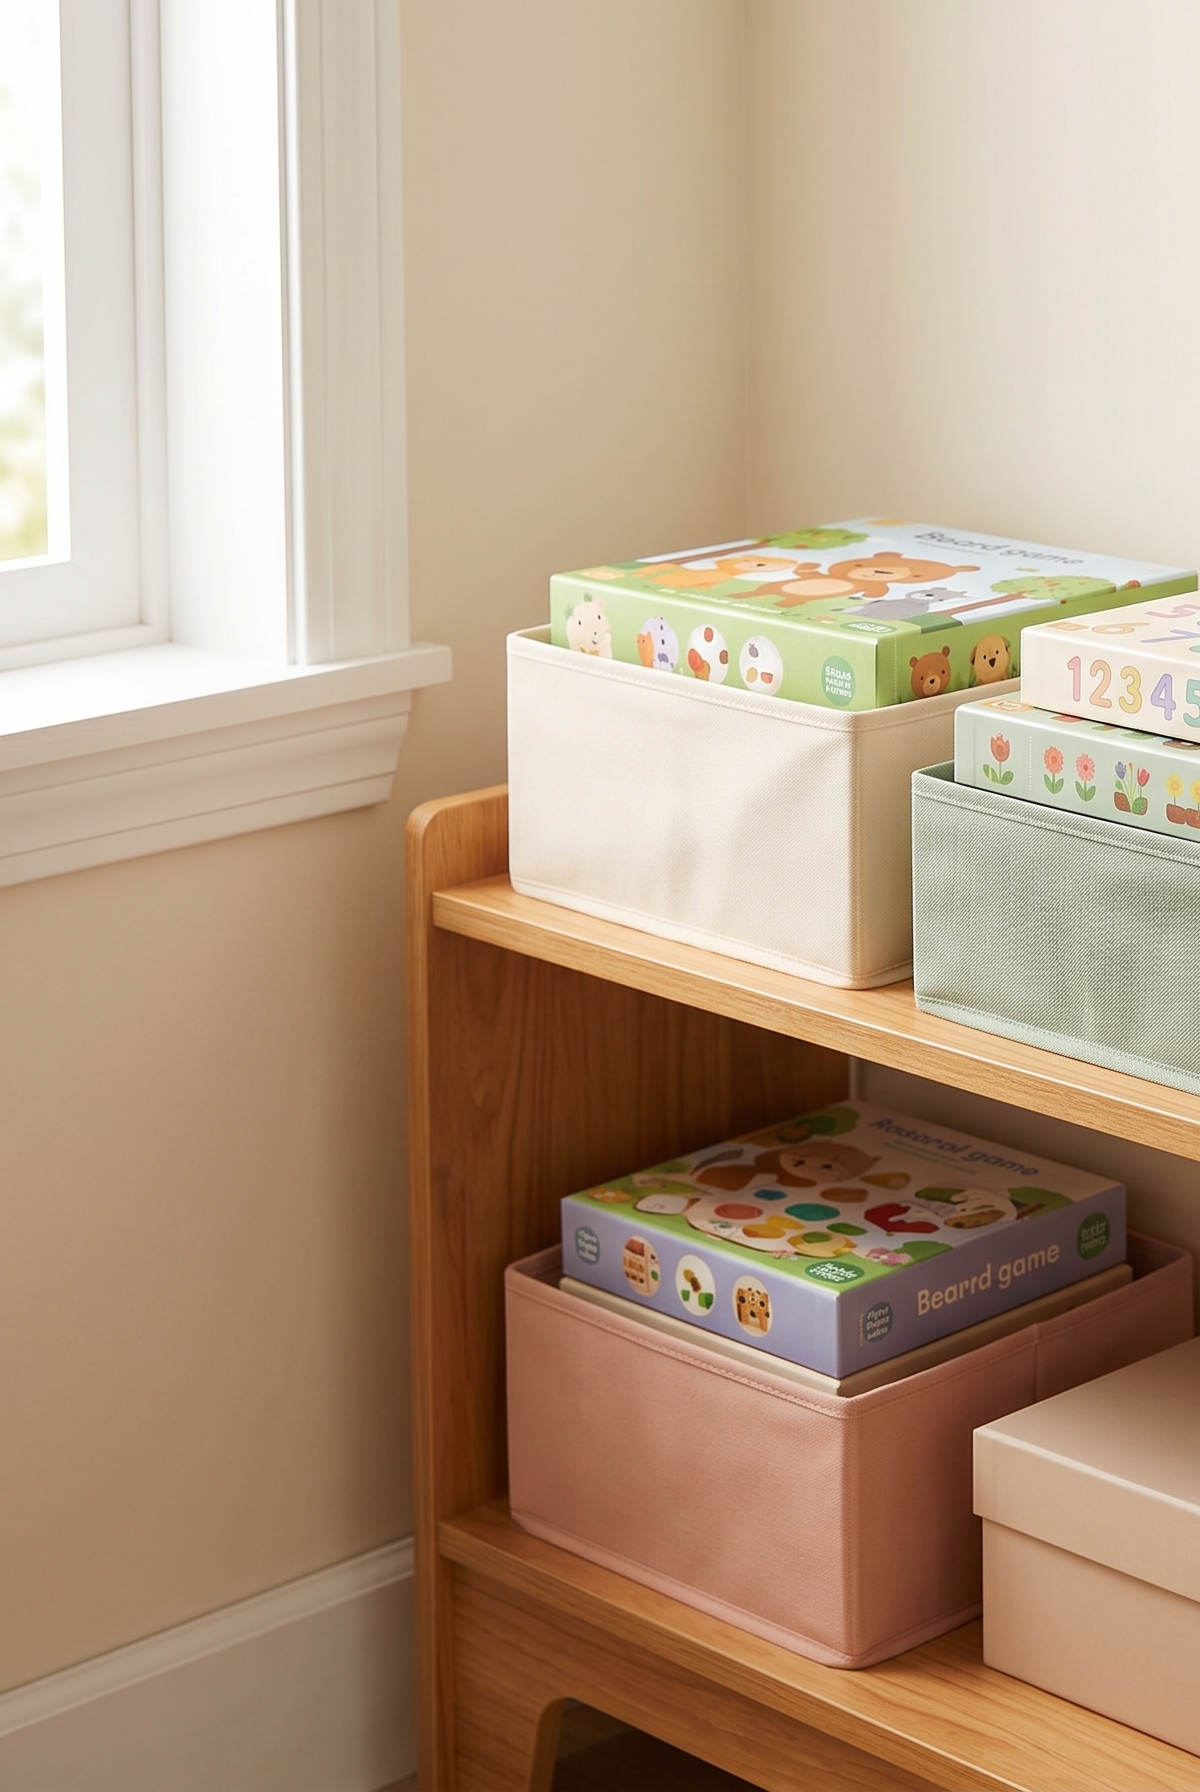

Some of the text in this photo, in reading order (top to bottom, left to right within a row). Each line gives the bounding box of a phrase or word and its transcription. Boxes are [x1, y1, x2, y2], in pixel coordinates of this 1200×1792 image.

[999, 549, 1084, 565] game
[961, 1150, 1039, 1176] game
[917, 1244, 1061, 1316] Bearrd game
